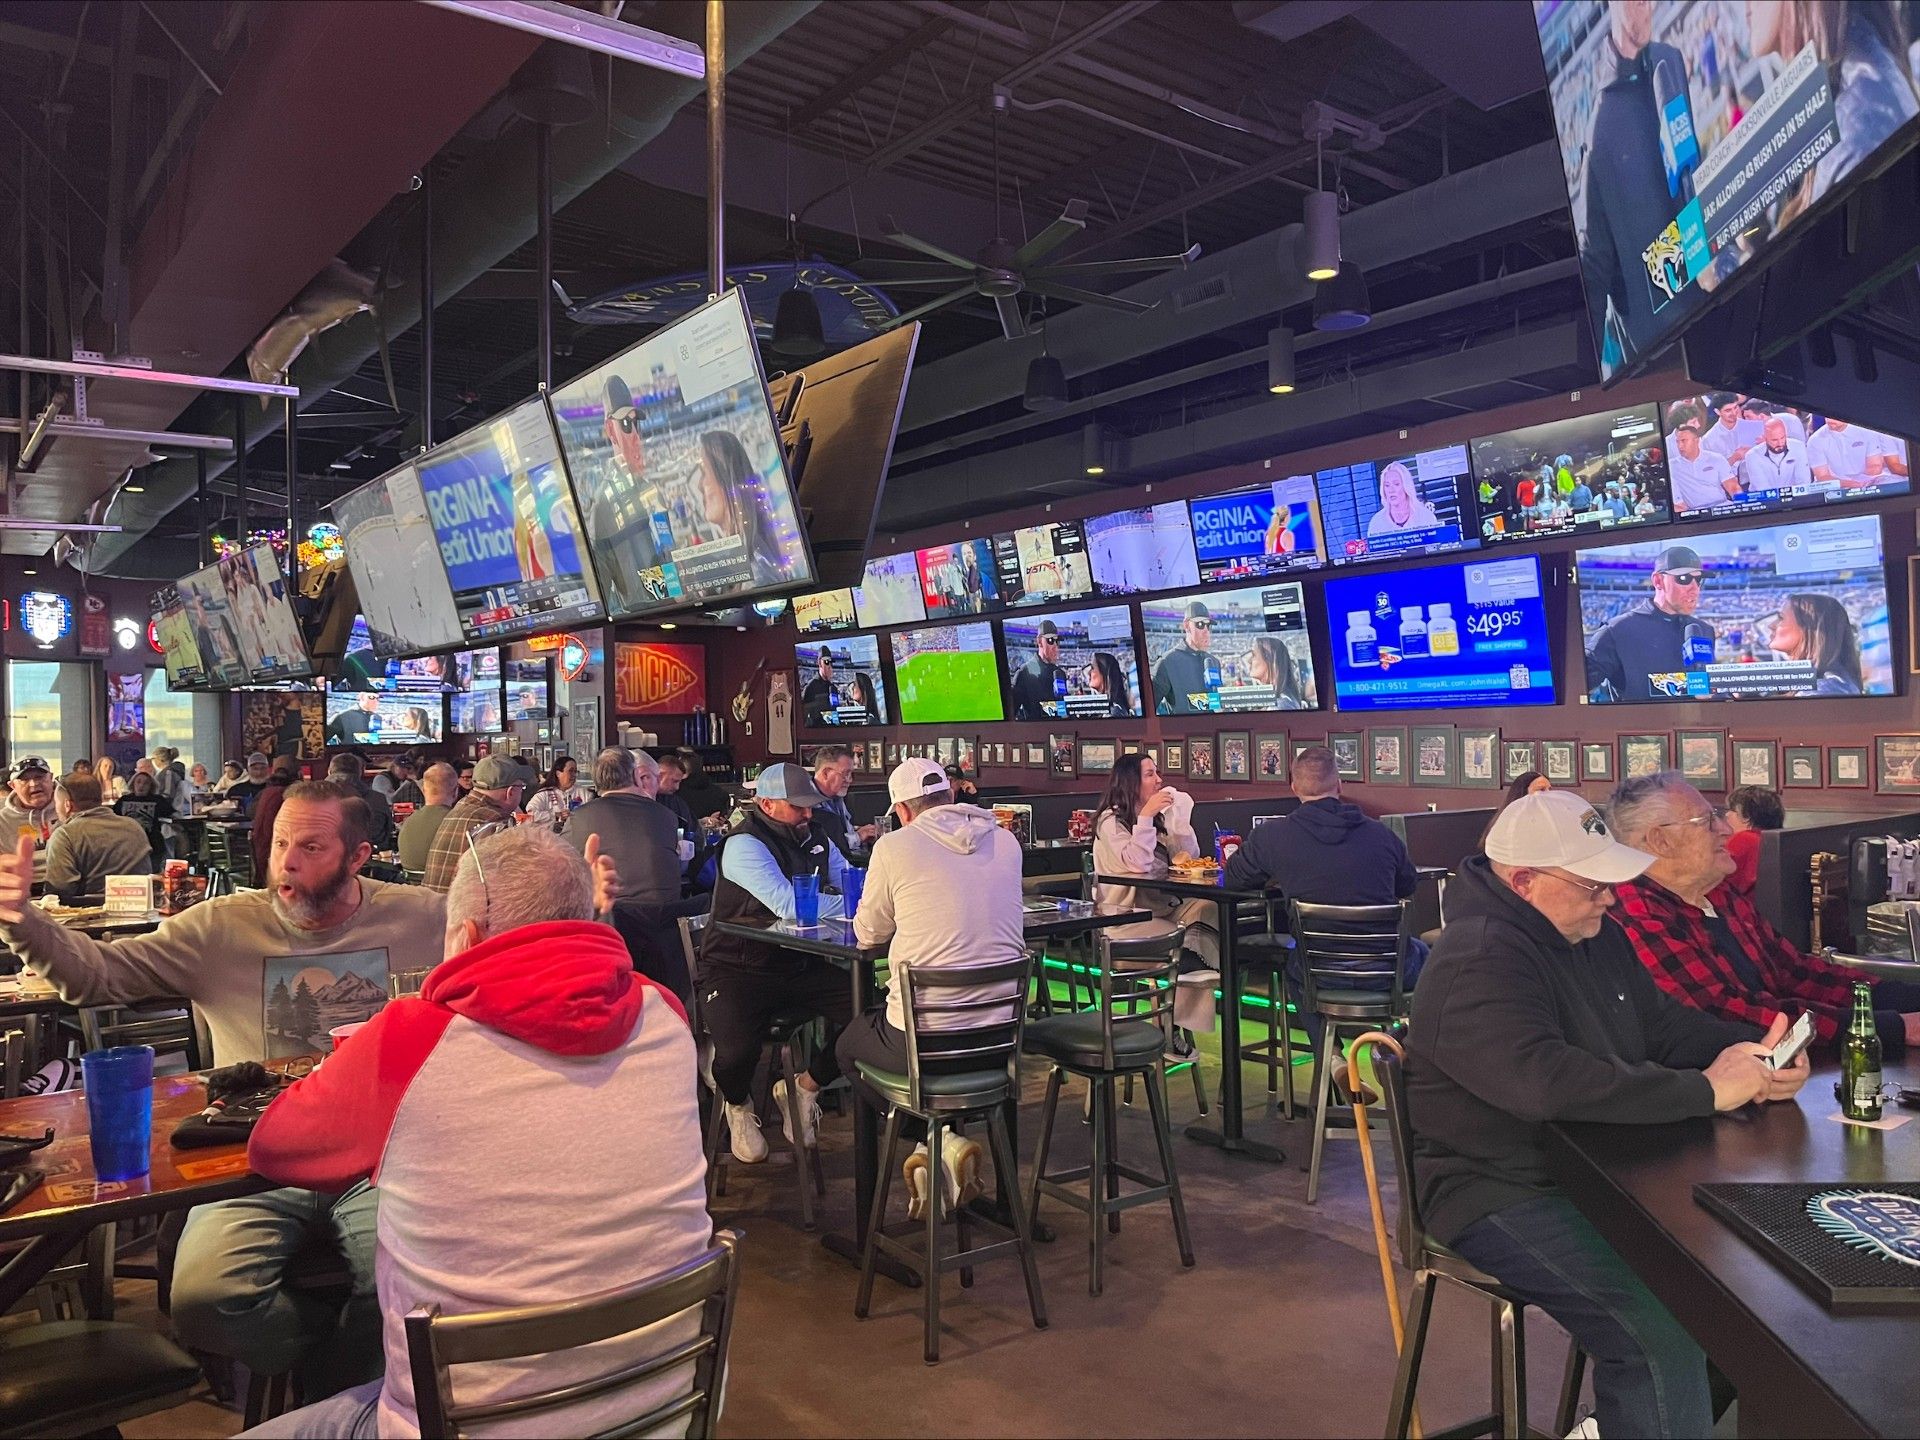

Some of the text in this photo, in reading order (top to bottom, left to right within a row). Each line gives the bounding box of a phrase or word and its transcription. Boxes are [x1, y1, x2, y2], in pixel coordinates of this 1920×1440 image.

[1709, 142, 1731, 170] COACH
[1733, 89, 1780, 145] JACKSONVILLE
[1713, 169, 1748, 212] ALLOWED
[1744, 162, 1755, 179] 43
[1751, 140, 1775, 171] RUSH
[1771, 127, 1789, 150] YDS
[1785, 117, 1797, 137] IN
[1805, 84, 1829, 117] HALF
[1727, 215, 1744, 236] 159.6
[1742, 198, 1761, 222] RUSH
[1758, 170, 1788, 207] YDS/GM
[1785, 155, 1804, 182] THIS
[1800, 129, 1834, 168] SEASON
[426, 475, 501, 530] RGINIA
[1766, 490, 1777, 498] 56
[1194, 505, 1256, 531] RGINIA
[441, 522, 514, 567] edit Union
[1197, 527, 1265, 548] edit Union
[1377, 598, 1388, 607] 30
[1478, 641, 1524, 650] FREE SHIPPING
[616, 650, 692, 703] KINGDOM
[1349, 681, 1408, 692] 1-800-471-9512
